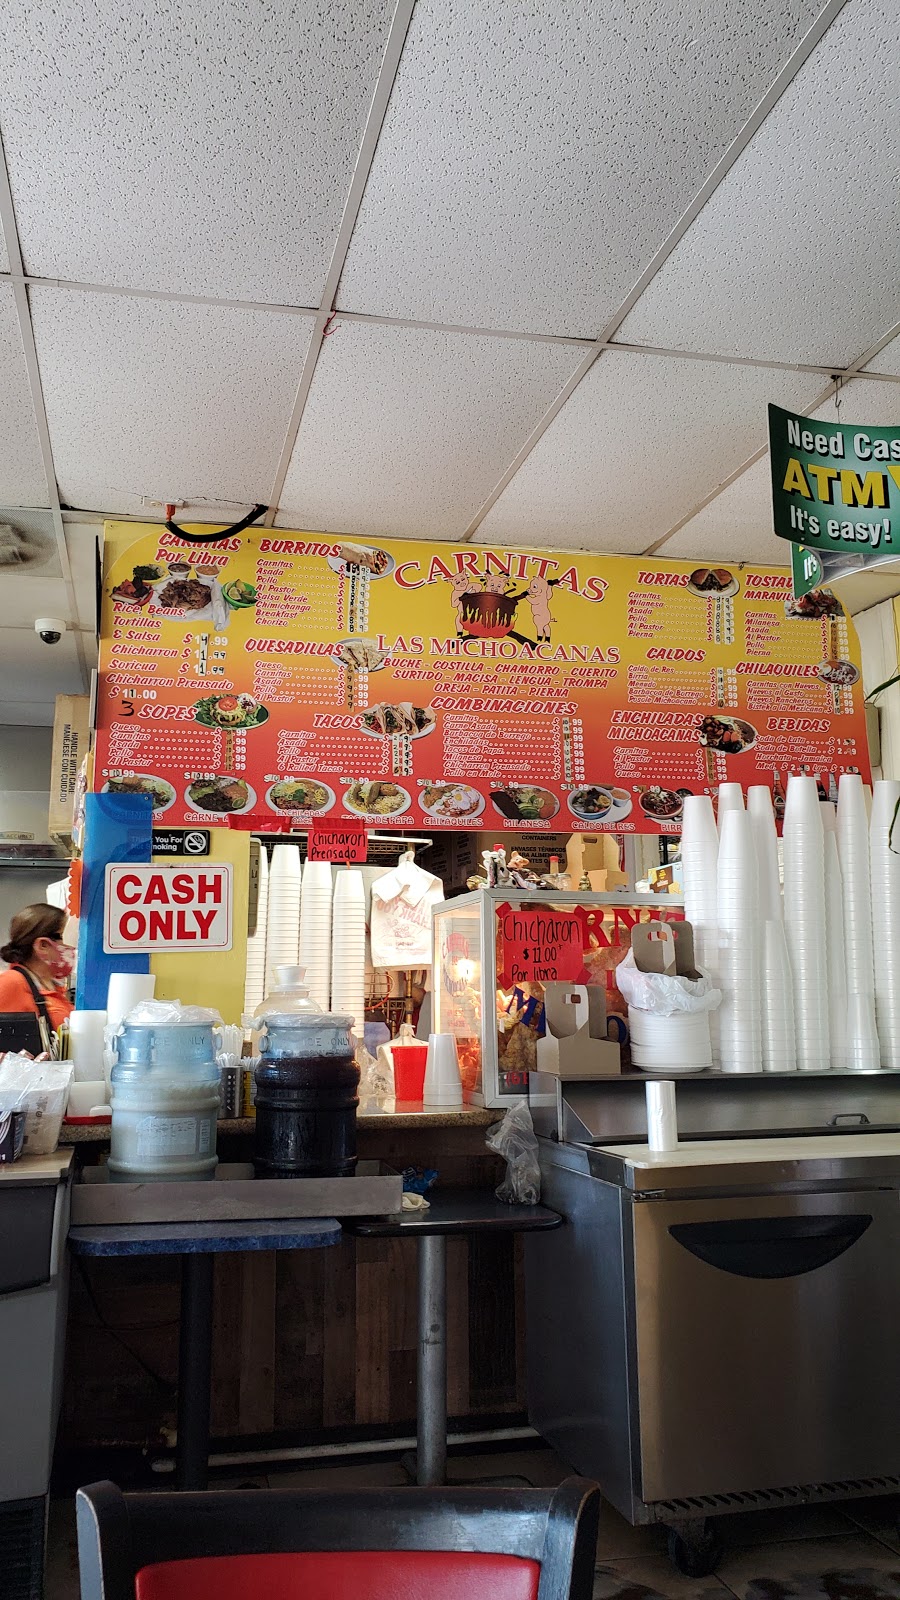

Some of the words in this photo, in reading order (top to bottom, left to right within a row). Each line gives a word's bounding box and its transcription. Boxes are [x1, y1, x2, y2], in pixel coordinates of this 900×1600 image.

[787, 419, 844, 456] Need
[854, 433, 900, 459] Cas
[782, 458, 885, 506] ATM
[790, 504, 820, 534] It's
[827, 518, 892, 546] easy!
[260, 538, 341, 557] BURRITOS
[154, 549, 184, 562] Por
[188, 551, 229, 566] Libra
[256, 559, 294, 568] Carnitas
[256, 568, 284, 576] Asada
[394, 551, 608, 602] CARNITAS
[256, 576, 278, 584] Pollo
[638, 572, 690, 586] TORTAS
[255, 584, 266, 592] Al
[268, 584, 295, 593] Pastor
[256, 592, 280, 600] Salsa
[284, 594, 308, 602] Verde
[628, 592, 662, 600] Carnitas
[256, 601, 311, 612] Chimichanga
[628, 600, 664, 608] Milanesa
[113, 603, 142, 614] Rice,
[148, 605, 187, 617] Beans,
[255, 610, 298, 618] Breakfast
[628, 607, 652, 615] Asada
[745, 611, 777, 619] Carnitas
[113, 616, 162, 628] Tortillas
[255, 618, 288, 626] Chorizo
[638, 623, 664, 631] Pastor
[126, 630, 160, 641] Salsa
[628, 630, 654, 638] Pierna
[111, 645, 179, 657] Chicharron
[244, 638, 344, 656] QUESADILLAS
[377, 634, 424, 653] LAS
[430, 638, 620, 664] MICHOACANAS
[646, 647, 706, 661] CALDOS
[109, 660, 157, 671] Soricua
[254, 660, 282, 669] Queso
[384, 658, 422, 668] BUCHE
[433, 661, 484, 672] COSTILLA
[494, 664, 559, 676] CHAMORRO
[570, 667, 618, 678] CUERITO
[736, 662, 820, 677] CHILAQUILES
[254, 669, 292, 678] Carnitas
[392, 670, 443, 681] SURTIDO
[453, 673, 498, 684] MACISA
[508, 676, 551, 686] LENGUA
[562, 678, 608, 688] TROMPA
[106, 673, 173, 687] Chicharron
[176, 678, 234, 690] Prensado
[254, 678, 282, 686] Asada
[254, 685, 276, 693] Pollo
[434, 683, 470, 694] OREJA
[481, 685, 518, 696] PATITA
[528, 686, 569, 698] PIERNA
[118, 700, 134, 717] 3
[431, 696, 578, 715] COMBINACIONES
[788, 705, 824, 713] Mexicana
[138, 704, 198, 721] SOPES
[443, 713, 479, 722] Carnitas
[611, 710, 705, 726] ENCHILADAS
[313, 714, 365, 728] TACOS
[767, 716, 830, 732] BEBIDAS
[110, 722, 140, 732] Queso
[110, 731, 150, 740] Carnitas
[278, 730, 316, 740] Carnitas
[443, 730, 484, 738] Barbacoa
[498, 732, 531, 741] Borrego
[608, 726, 702, 742] MICHOACANAS
[62, 724, 71, 757] MANEJESE
[70, 732, 78, 758] HANDLE
[109, 740, 140, 749] Asada
[277, 738, 307, 747] Asada
[443, 738, 488, 746] Enchiladas
[109, 749, 133, 758] Pollo
[277, 747, 301, 755] Pollo
[613, 746, 649, 755] Carnitas
[754, 744, 775, 752] Soda
[122, 758, 153, 767] Pastor
[626, 755, 652, 763] Pastor
[288, 764, 316, 772] Rolled
[318, 764, 343, 772] Tacos
[443, 761, 490, 769] Chicharron
[491, 763, 531, 772] Prensado
[60, 774, 68, 802] CUIDADO
[184, 814, 218, 822] CARNE
[423, 818, 484, 826] CHILAQUILES
[503, 820, 551, 828] MILANESA
[572, 822, 602, 830] CALDO
[604, 822, 616, 830] DE
[618, 822, 636, 830] RES
[311, 846, 356, 860] Prensado
[116, 874, 222, 904] CASH
[119, 910, 218, 940] ONLY
[503, 915, 580, 944] Chicharon
[512, 964, 528, 982] Por
[534, 966, 558, 981] libra
